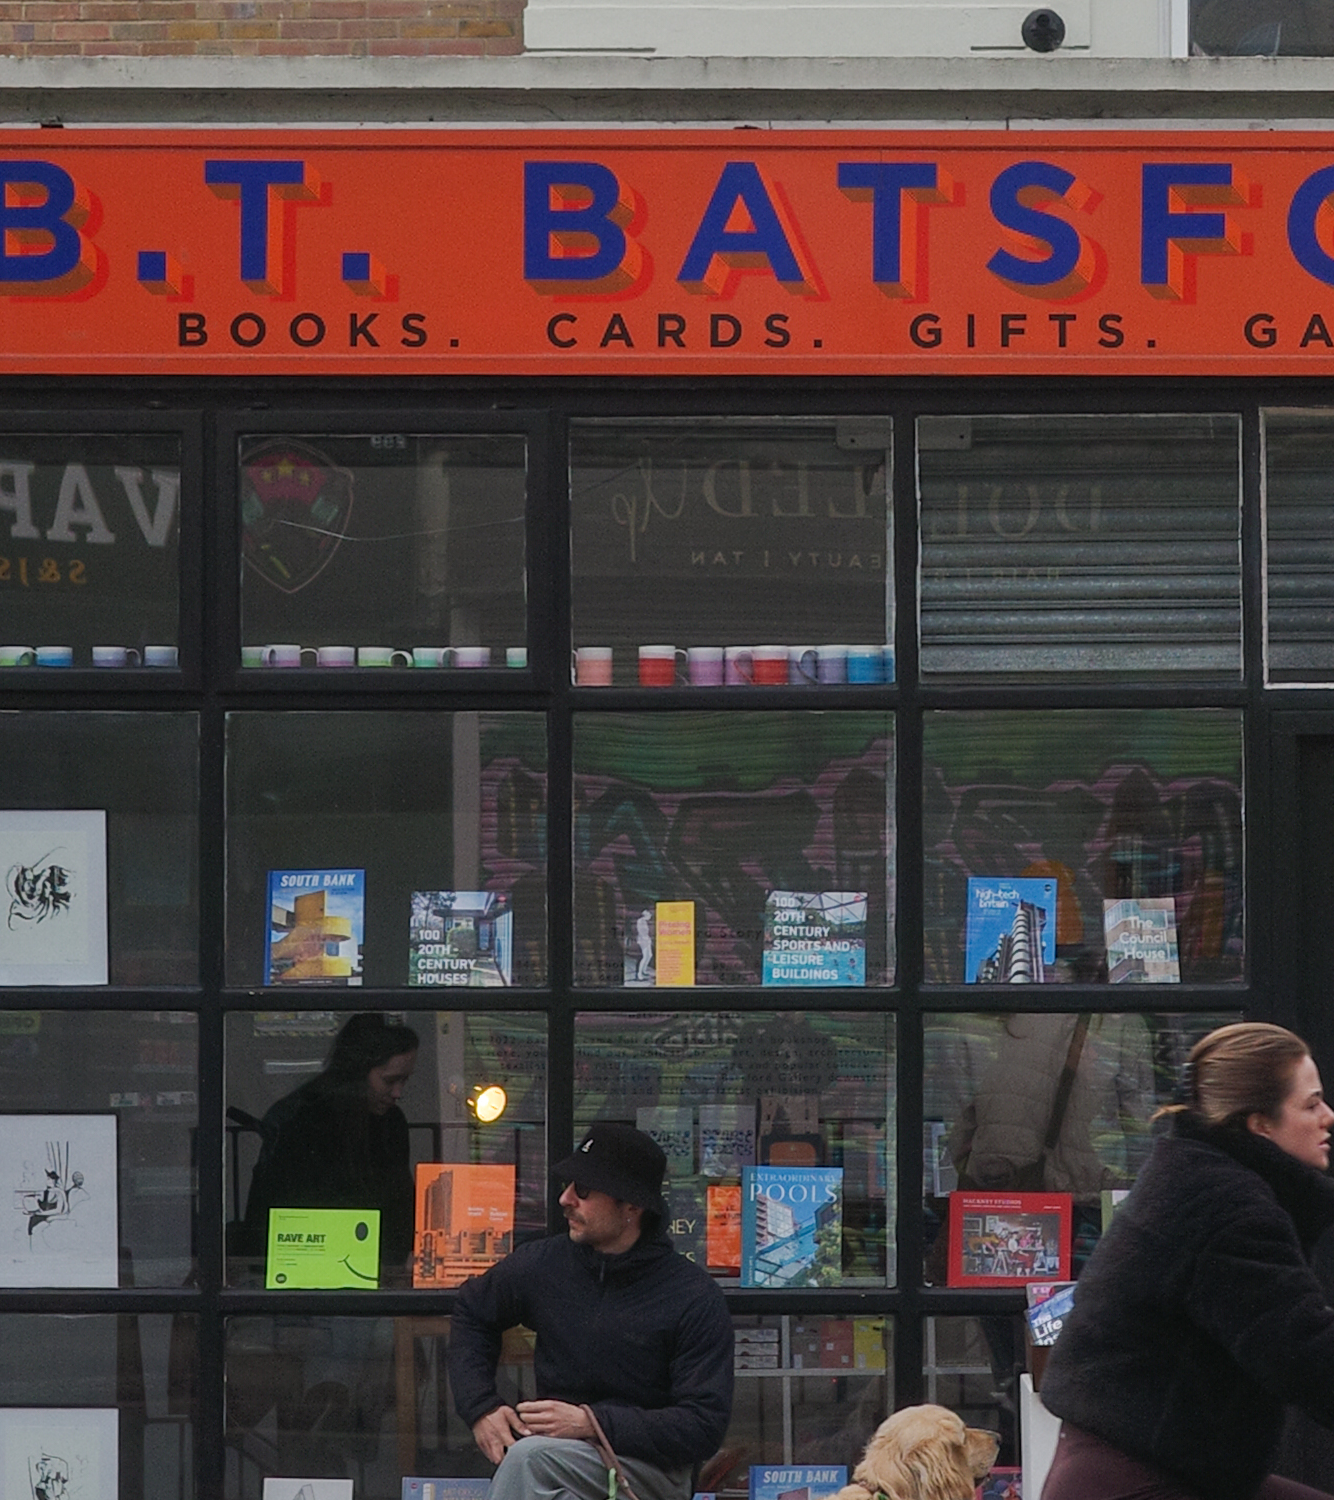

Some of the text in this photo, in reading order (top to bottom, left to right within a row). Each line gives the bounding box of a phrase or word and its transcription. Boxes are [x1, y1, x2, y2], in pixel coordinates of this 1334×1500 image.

[178, 314, 460, 349] BOOKS.
[546, 313, 824, 349] CARDS.
[909, 313, 1155, 350] GIFTS.
[280, 873, 355, 887] SOUTH BANK
[774, 897, 795, 908] 100
[1129, 916, 1154, 929] The
[418, 930, 440, 940] 100
[773, 925, 830, 937] CENTURY
[1119, 931, 1167, 944] Council
[773, 939, 851, 952] SPORTS AND
[772, 953, 824, 966] LEISURE
[1124, 946, 1167, 960] House
[417, 958, 476, 971] CENTURY
[417, 973, 468, 985] HOUSES
[771, 967, 838, 981] BUILDINGS
[750, 1173, 839, 1183] EXTRAORDINARY
[749, 1184, 838, 1203] POOLS
[277, 1233, 327, 1243] RAVE ART
[1031, 1314, 1053, 1328] The
[1033, 1319, 1063, 1340] Life
[763, 1470, 838, 1484] SOUTH BANK
